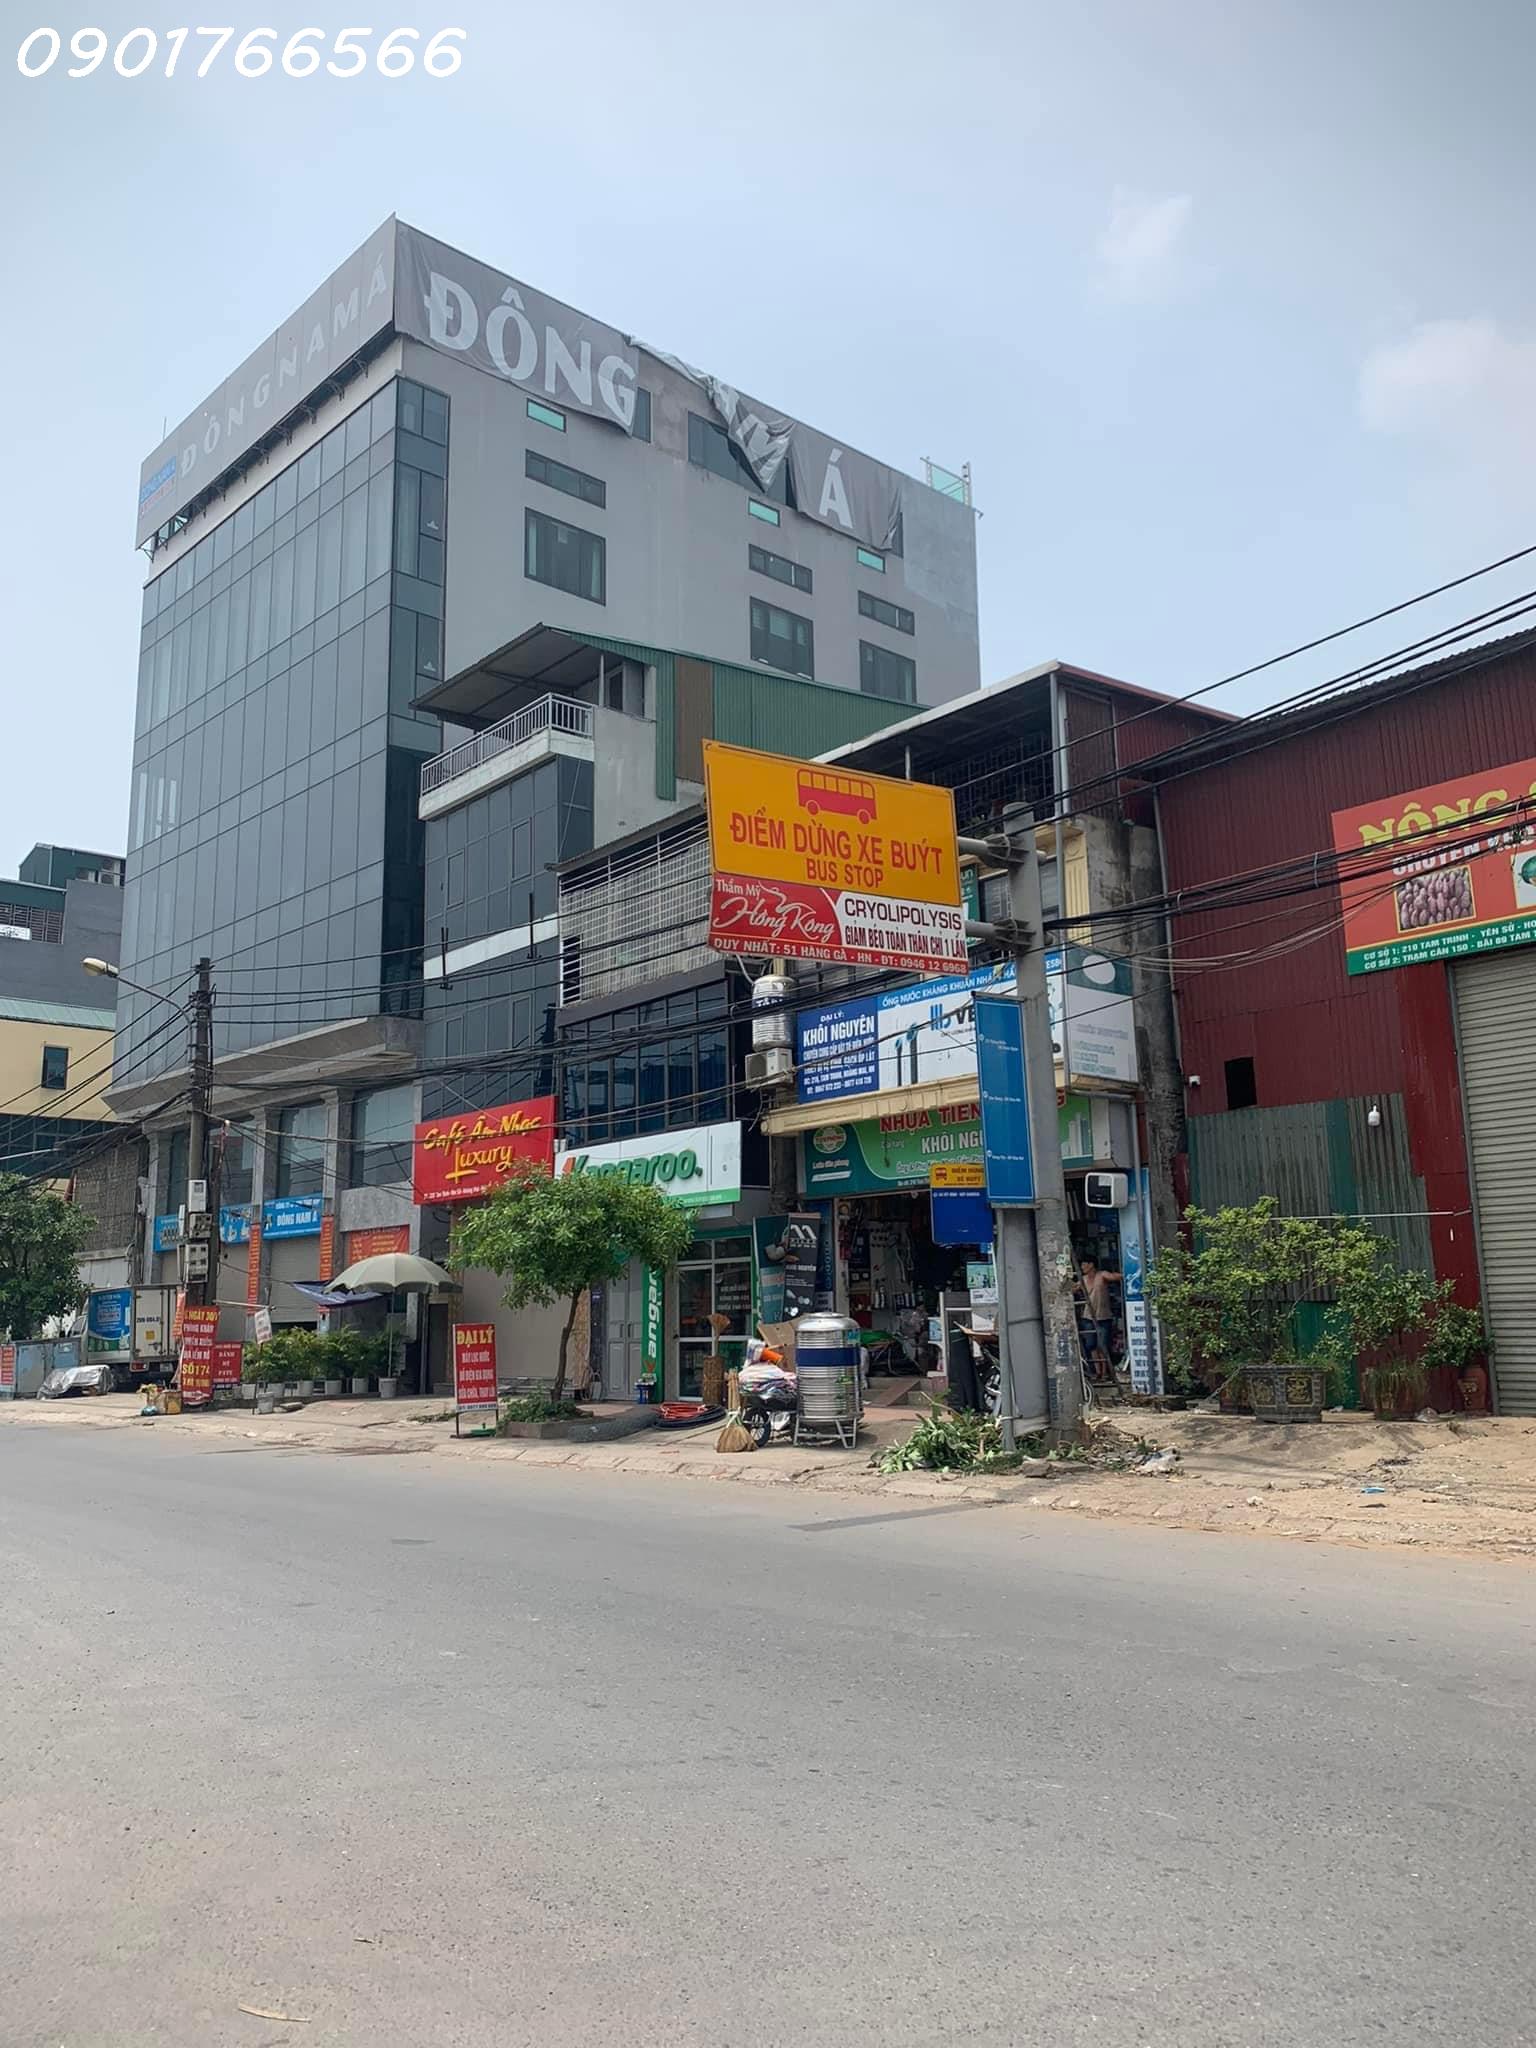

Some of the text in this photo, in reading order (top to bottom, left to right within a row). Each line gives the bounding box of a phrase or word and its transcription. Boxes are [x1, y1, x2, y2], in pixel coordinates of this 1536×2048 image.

[425, 271, 638, 428] ĐÔNG
[730, 806, 943, 874] ĐIỂM DỪNG XE BUÝT
[716, 878, 744, 896] Thẩm
[806, 858, 883, 888] BUS STOP
[845, 898, 962, 930] CRYOLIPOLYSIS
[845, 921, 867, 947] GIẢM
[869, 925, 885, 949] BÉO
[885, 928, 907, 953] TOÀN
[944, 935, 950, 957] 1
[1421, 939, 1440, 950] TAM
[1480, 926, 1499, 942] YÊN
[1509, 931, 1531, 942] TAM
[714, 937, 740, 951] DUY
[743, 939, 781, 954] NHẤT:
[783, 941, 797, 956] 51
[801, 942, 831, 960] HÀNG
[833, 945, 848, 961] GÀ
[857, 952, 872, 963] HN
[900, 957, 926, 970] 0946
[928, 960, 941, 971] 12
[803, 1014, 875, 1048] KHÔI NGUYÊN
[879, 1109, 930, 1136] NHỰA
[921, 1131, 954, 1154] KHÔI
[445, 1145, 512, 1184] Luxury
[456, 1326, 494, 1348] ĐẠI LÝ
